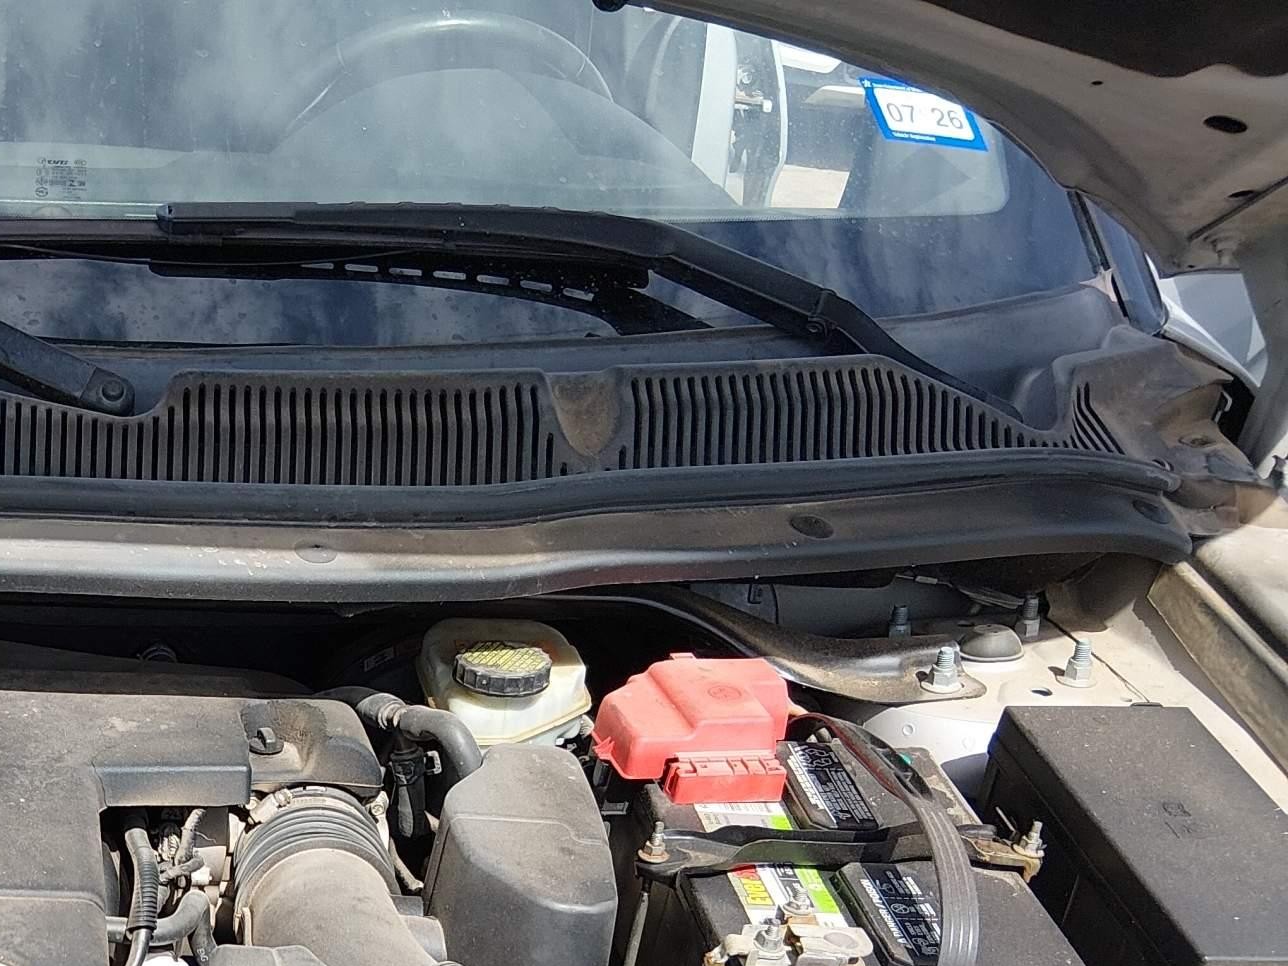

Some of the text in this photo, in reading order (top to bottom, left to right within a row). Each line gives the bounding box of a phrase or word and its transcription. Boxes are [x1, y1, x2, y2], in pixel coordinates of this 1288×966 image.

[886, 102, 963, 130] 07 26
[878, 909, 904, 937] DANGER
